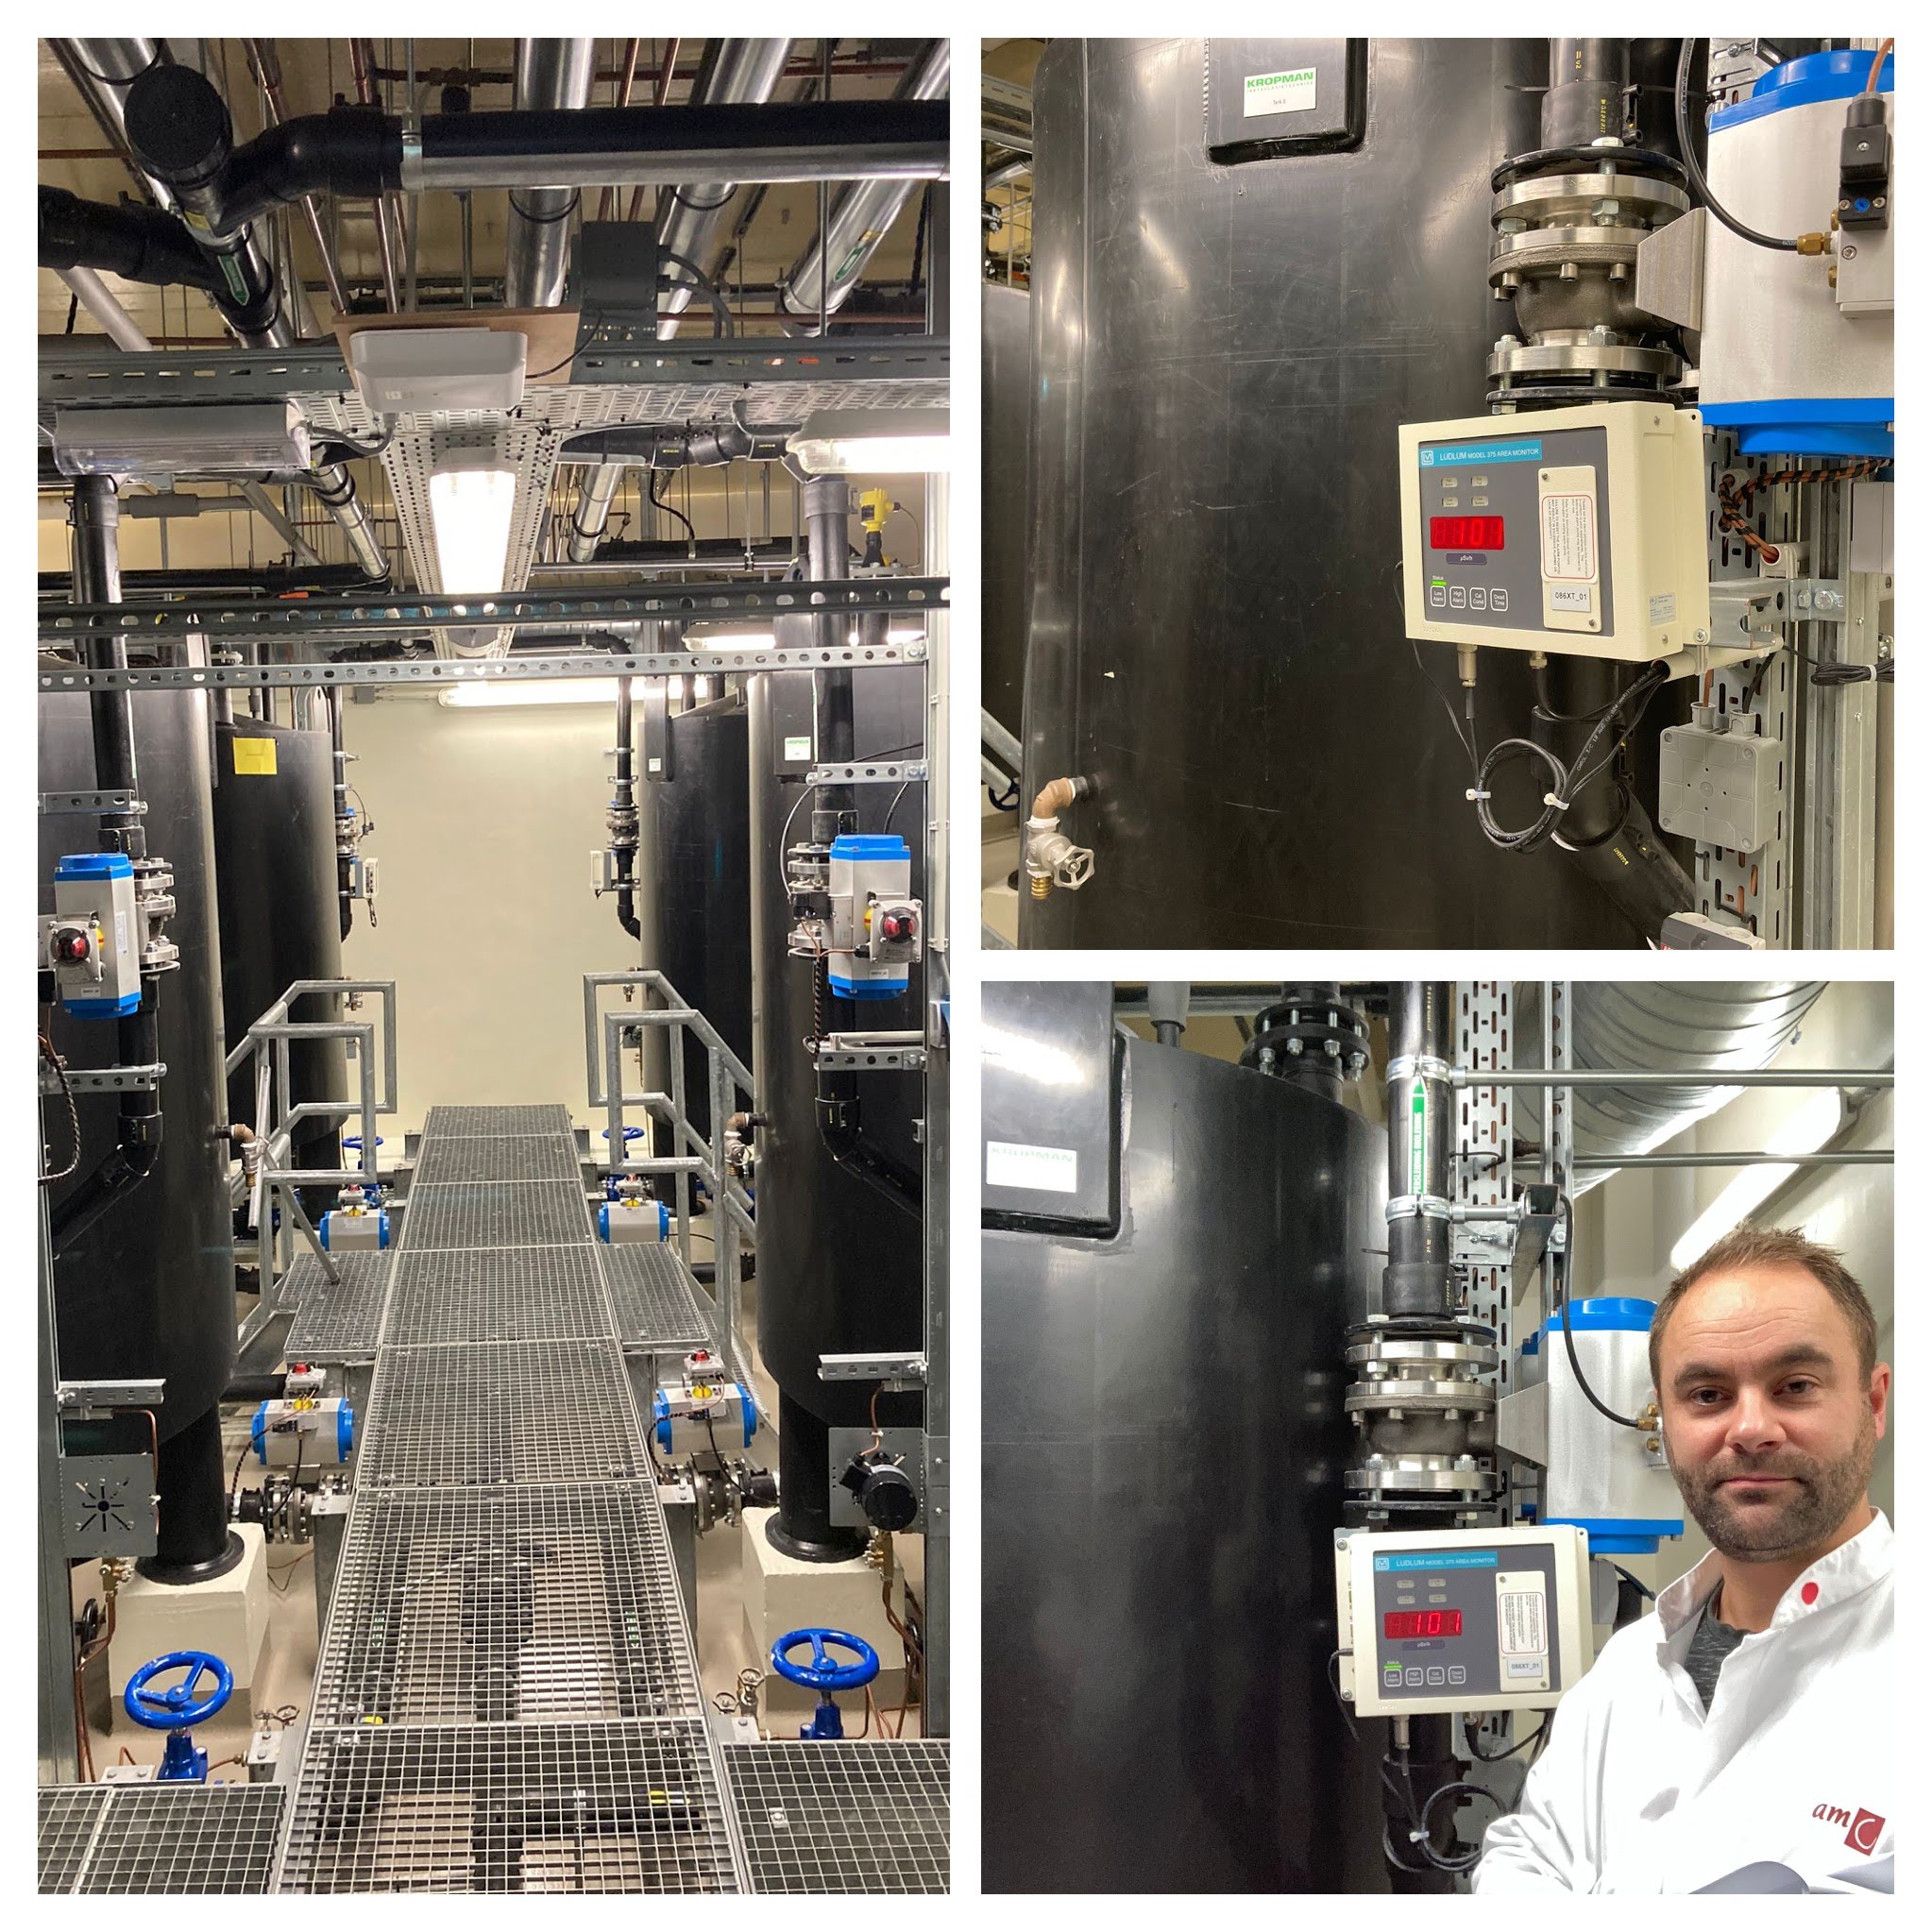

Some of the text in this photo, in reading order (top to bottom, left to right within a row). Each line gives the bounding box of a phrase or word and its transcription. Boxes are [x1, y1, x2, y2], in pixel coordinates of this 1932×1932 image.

[1247, 72, 1313, 88] KROPMAN
[1440, 452, 1467, 461] LUDLUM
[1512, 448, 1539, 456] MONITOR
[1460, 519, 1502, 546] 101
[1555, 592, 1587, 602] 086XT_01
[1417, 1612, 1460, 1635] 101
